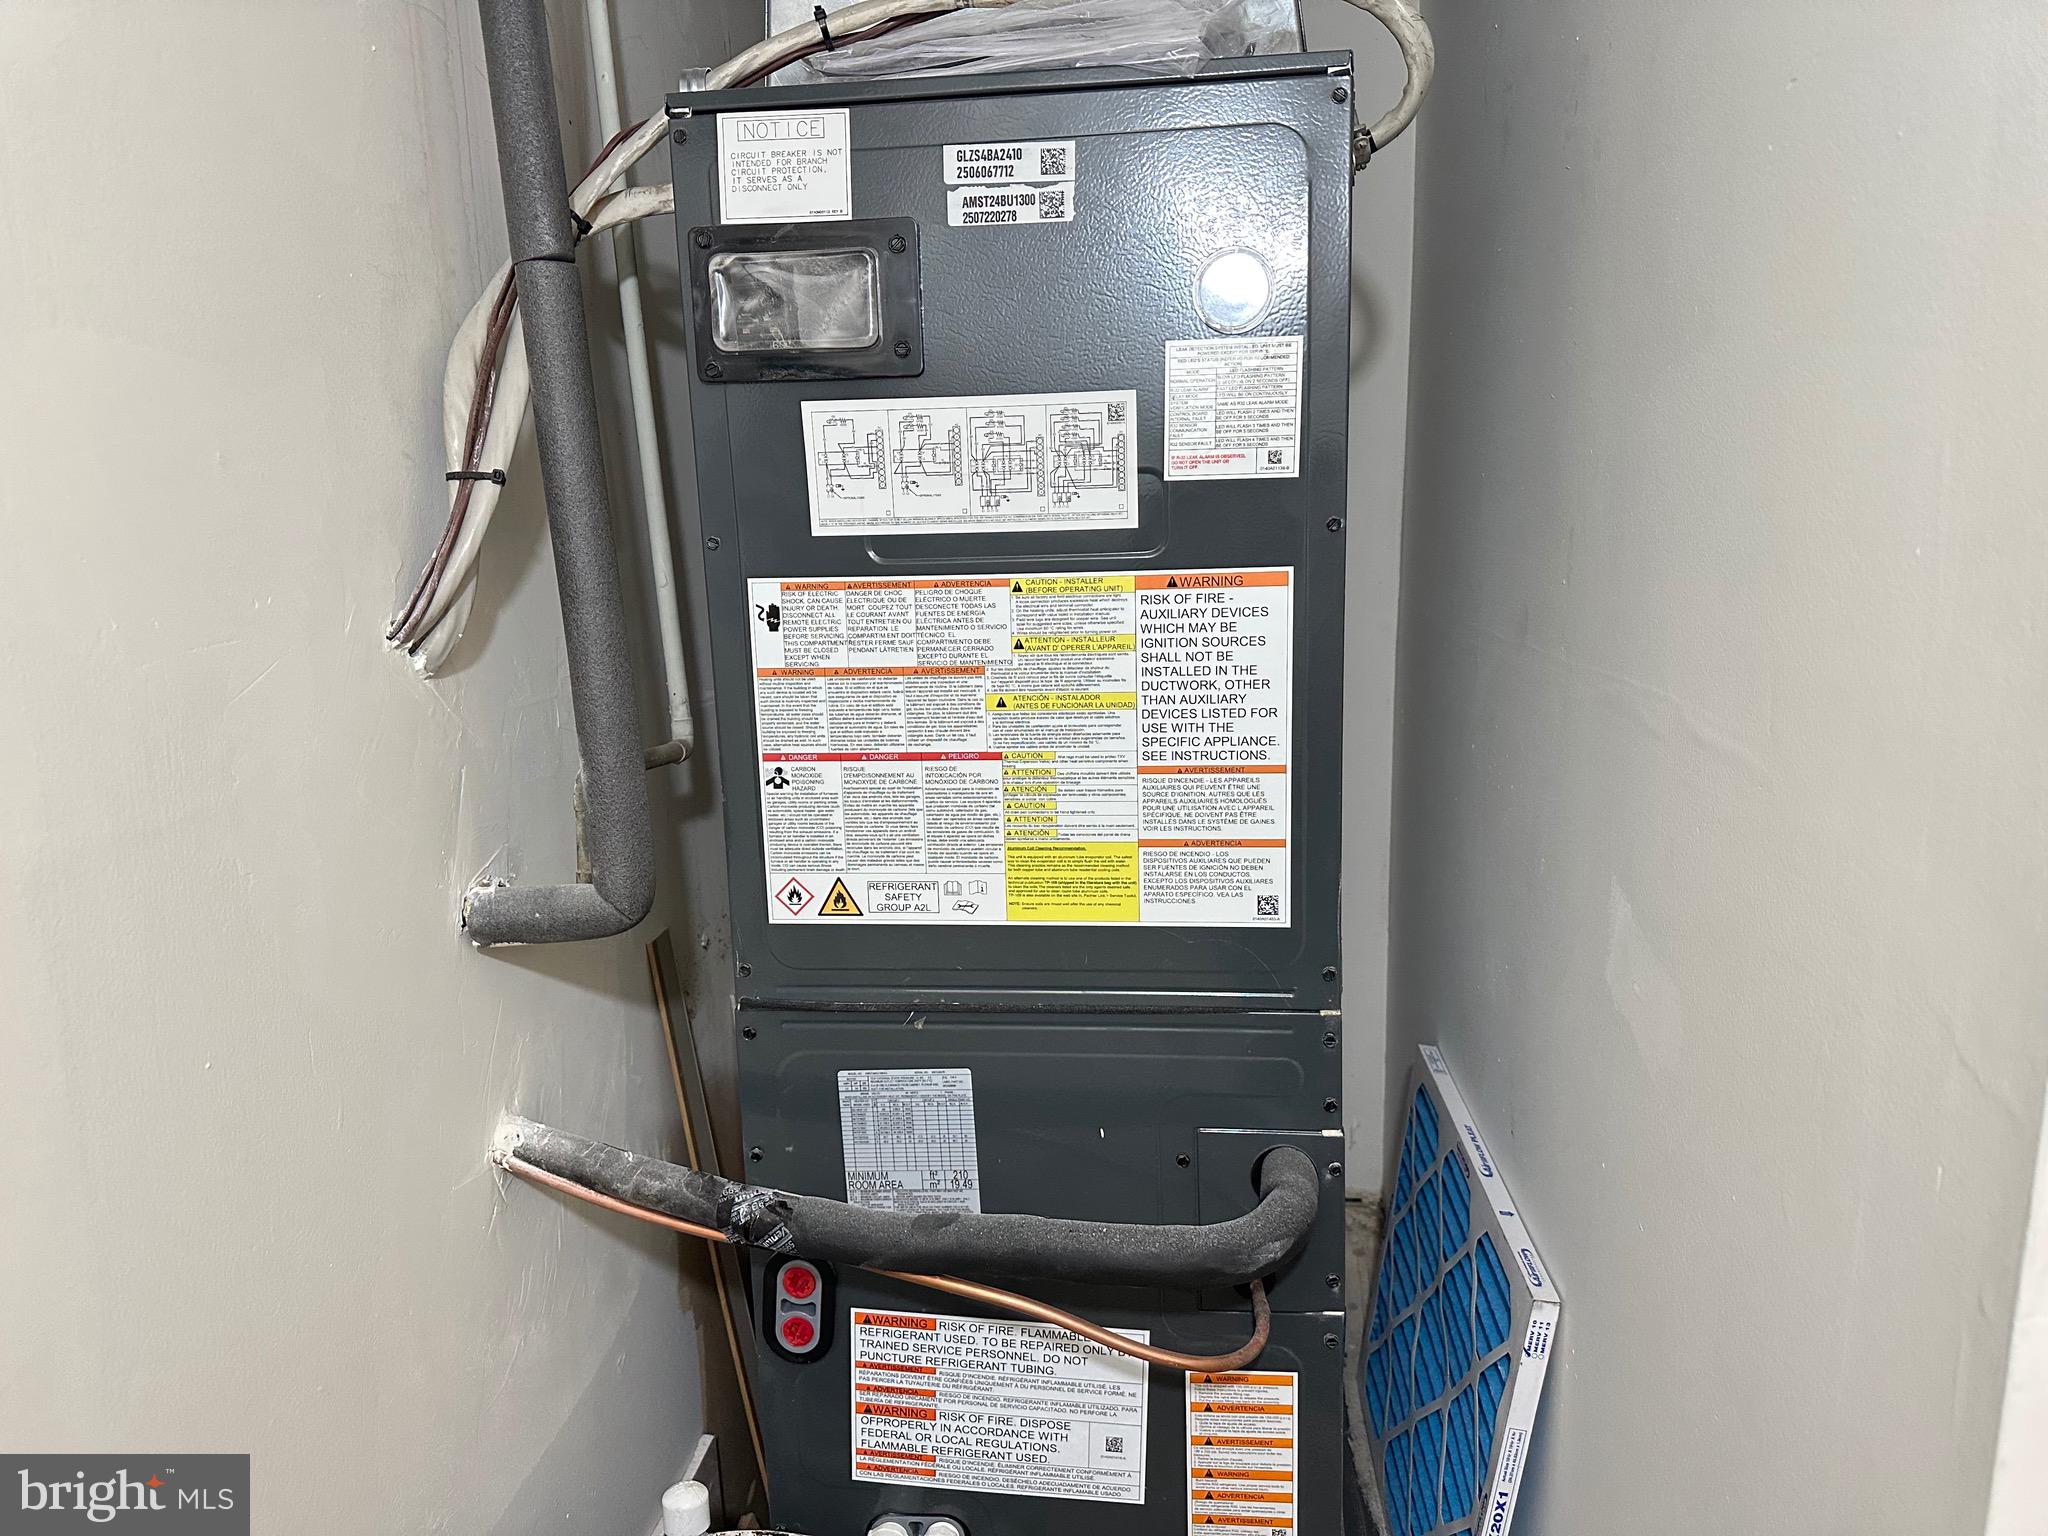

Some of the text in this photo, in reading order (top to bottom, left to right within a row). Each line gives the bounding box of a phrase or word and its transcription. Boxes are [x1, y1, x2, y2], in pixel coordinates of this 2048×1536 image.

[743, 120, 821, 139] NOTICE
[730, 152, 767, 160] CIRCUIT
[771, 150, 807, 158] BREAKER
[827, 148, 842, 156] NOT
[956, 148, 1022, 162] GLZS4BA2410
[732, 160, 771, 168] INTENDED
[731, 166, 827, 176] CIRCUIT PROTECTION.
[957, 165, 1014, 178] 2506067712
[746, 176, 777, 184] SERVES
[732, 184, 782, 192] DISCONNECT
[962, 194, 1036, 208] AMST24BU1300
[963, 210, 1017, 224] 2507220278
[1180, 576, 1244, 587] WARNING
[1026, 586, 1058, 594] (BEFORE
[1140, 593, 1225, 605] RISK OF FIRE
[1140, 606, 1269, 619] AUXILIARY DEVICES
[1140, 622, 1237, 634] WHICH MAY BE
[1140, 636, 1266, 648] IGNITION SOURCES
[1141, 651, 1234, 662] SHALL NOT BE
[1141, 665, 1258, 677] INSTALLED IN THE
[1141, 679, 1271, 691] DUCTWORK, OTHER
[1142, 694, 1247, 705] THAN AUXILIARY
[1141, 708, 1278, 719] DEVICES LISTED FOR
[1142, 722, 1234, 733] USE WITH THE
[1142, 736, 1280, 747] SPECIFIC APPLIANCE.
[1142, 750, 1270, 761] SEE INSTRUCTIONS.
[885, 893, 922, 901] SAFETY
[848, 1172, 888, 1180] MINIMUM
[953, 1170, 968, 1179] 210
[849, 1181, 876, 1189] ROOM
[880, 1181, 903, 1189] AREA
[874, 1316, 1091, 1342] WARNING RISK OF FIRE. FLAMMABL
[860, 1327, 940, 1342] REFRIGERANT
[944, 1333, 978, 1345] USED.
[982, 1337, 998, 1346] TO
[1002, 1339, 1016, 1348] BE
[1020, 1340, 1079, 1352] REPAIRED
[1083, 1345, 1114, 1356] ONLY
[1540, 1333, 1548, 1353] MERV
[860, 1339, 1088, 1366] TRAINED SERVICE PERSONNEL. DO NOT
[860, 1351, 1056, 1375] PUNCTURE REFRIGERANT TUBING.
[873, 1405, 1071, 1430] WARNING RISK OF FIRE. DISPOSE
[861, 1416, 1068, 1442] OFPROPERLY IN ACCORDANCE WITH
[861, 1428, 1060, 1453] FEDERAL OR LOCAL REGULATIONS.
[861, 1439, 1050, 1464] FLAMMABLE REFRIGERANT USED.
[1486, 1491, 1509, 1536] 20X1
[1218, 1517, 1273, 1525] AVERTISSEMENT
